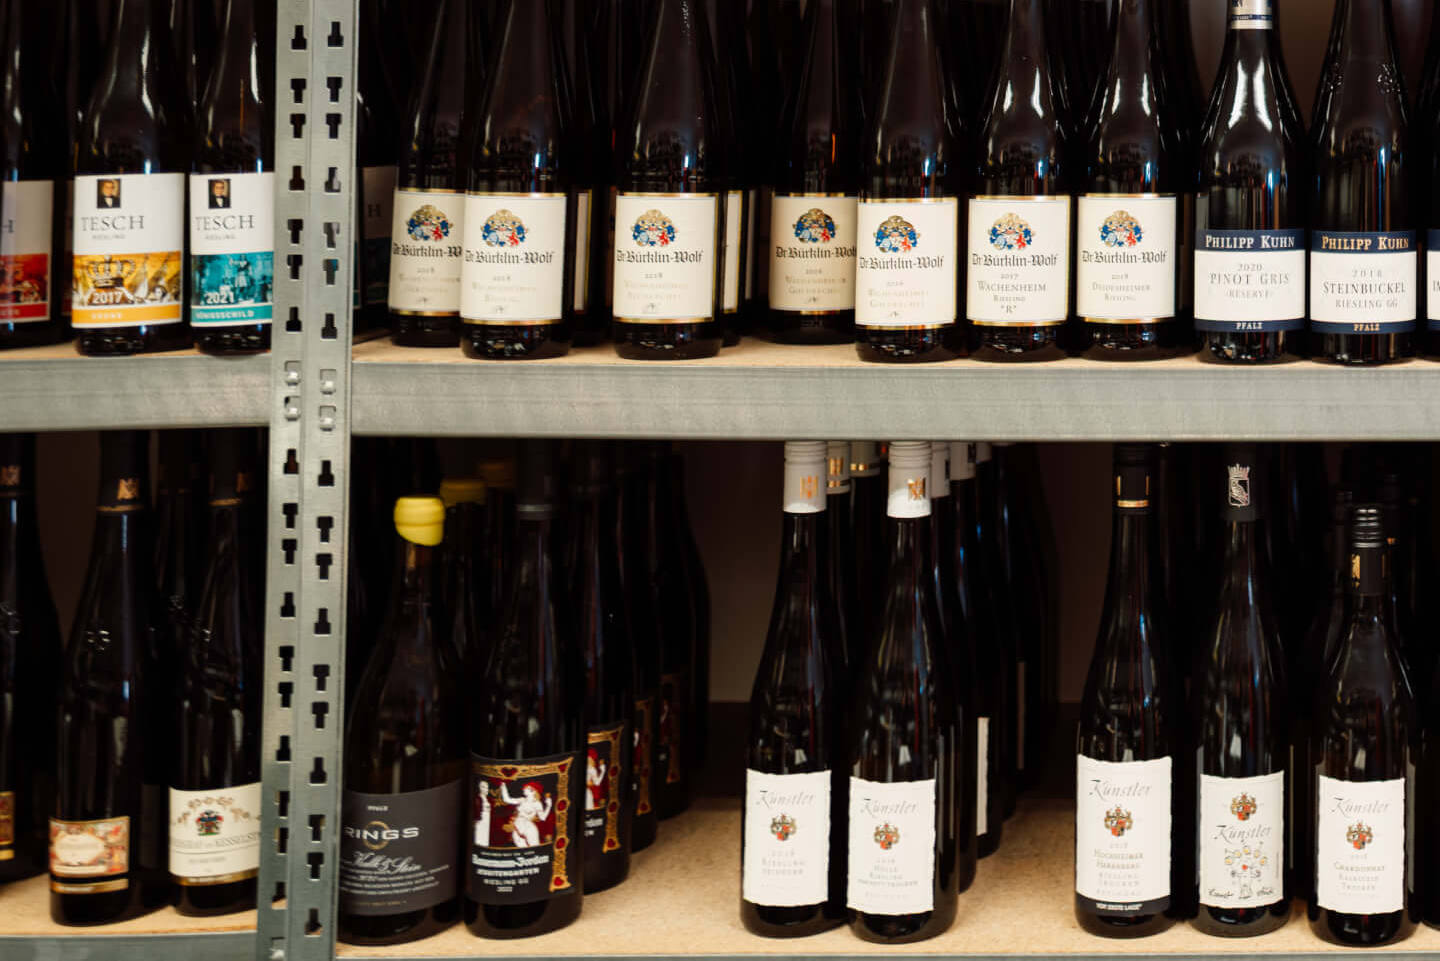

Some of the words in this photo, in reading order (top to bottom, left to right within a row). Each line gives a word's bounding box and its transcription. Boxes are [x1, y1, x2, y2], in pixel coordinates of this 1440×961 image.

[81, 215, 145, 231] TESCH
[196, 215, 255, 231] TESCH
[1206, 235, 1253, 248] PHILIPP
[1261, 235, 1295, 248] KUHN
[1322, 236, 1372, 250] PHILIPP
[1378, 237, 1408, 249] KUHN
[1238, 263, 1261, 271] 2020
[1210, 273, 1251, 284] PINOT
[1260, 273, 1289, 284] GRIS
[977, 282, 1047, 292] WACHENHEIM
[1324, 282, 1405, 294] STEINBUCKEL
[92, 290, 121, 304] 2017
[207, 291, 234, 304] 2021
[1335, 299, 1382, 308] RIESLING
[1386, 299, 1398, 307] GG
